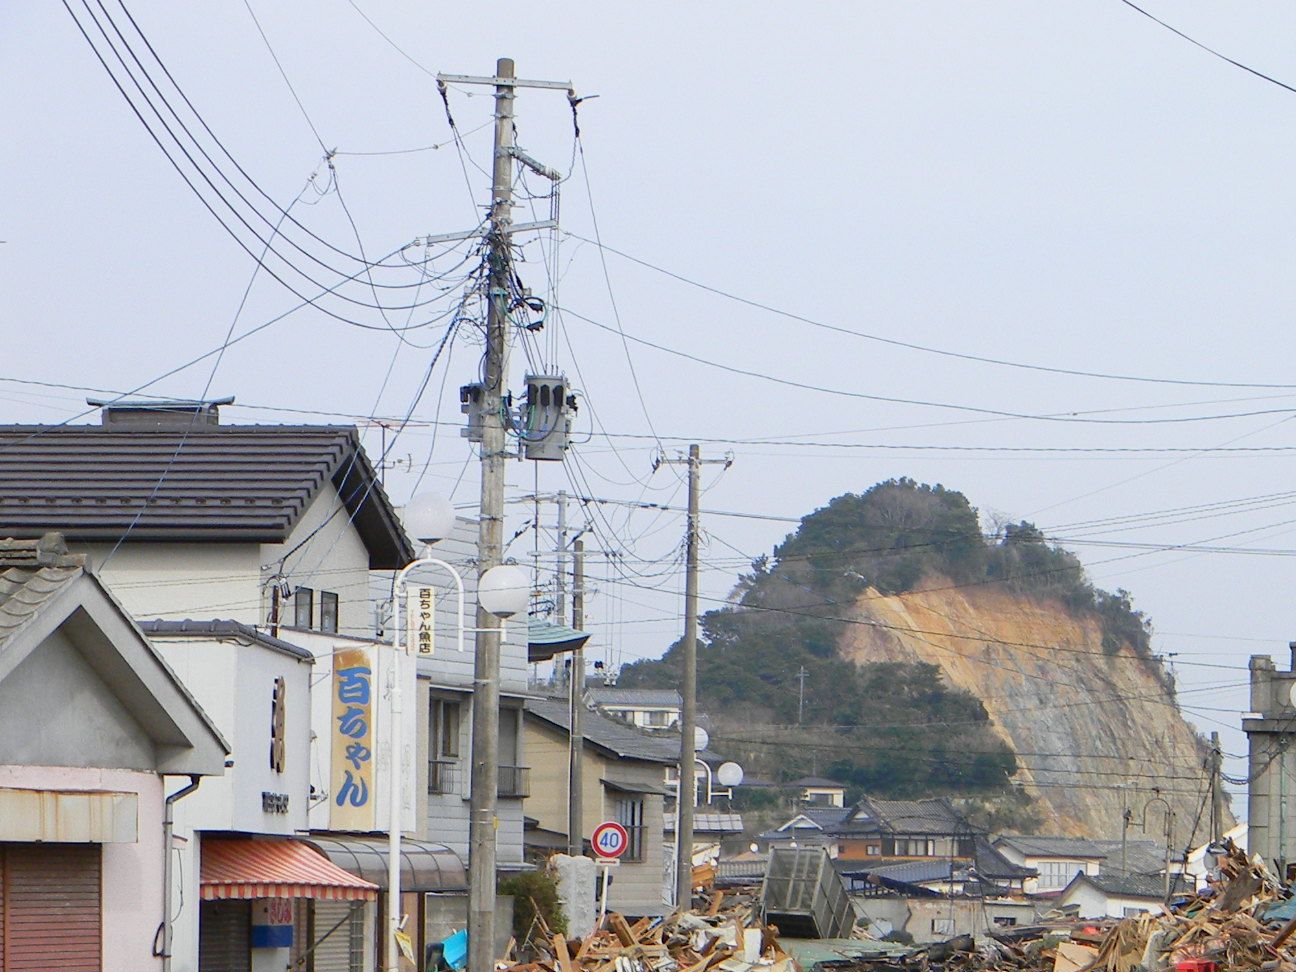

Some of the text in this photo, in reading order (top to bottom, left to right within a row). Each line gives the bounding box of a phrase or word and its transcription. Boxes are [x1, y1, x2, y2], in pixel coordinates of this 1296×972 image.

[418, 588, 431, 654] 百ちゃん魚店
[336, 666, 372, 808] 百ちゃん
[599, 832, 619, 848] 40
